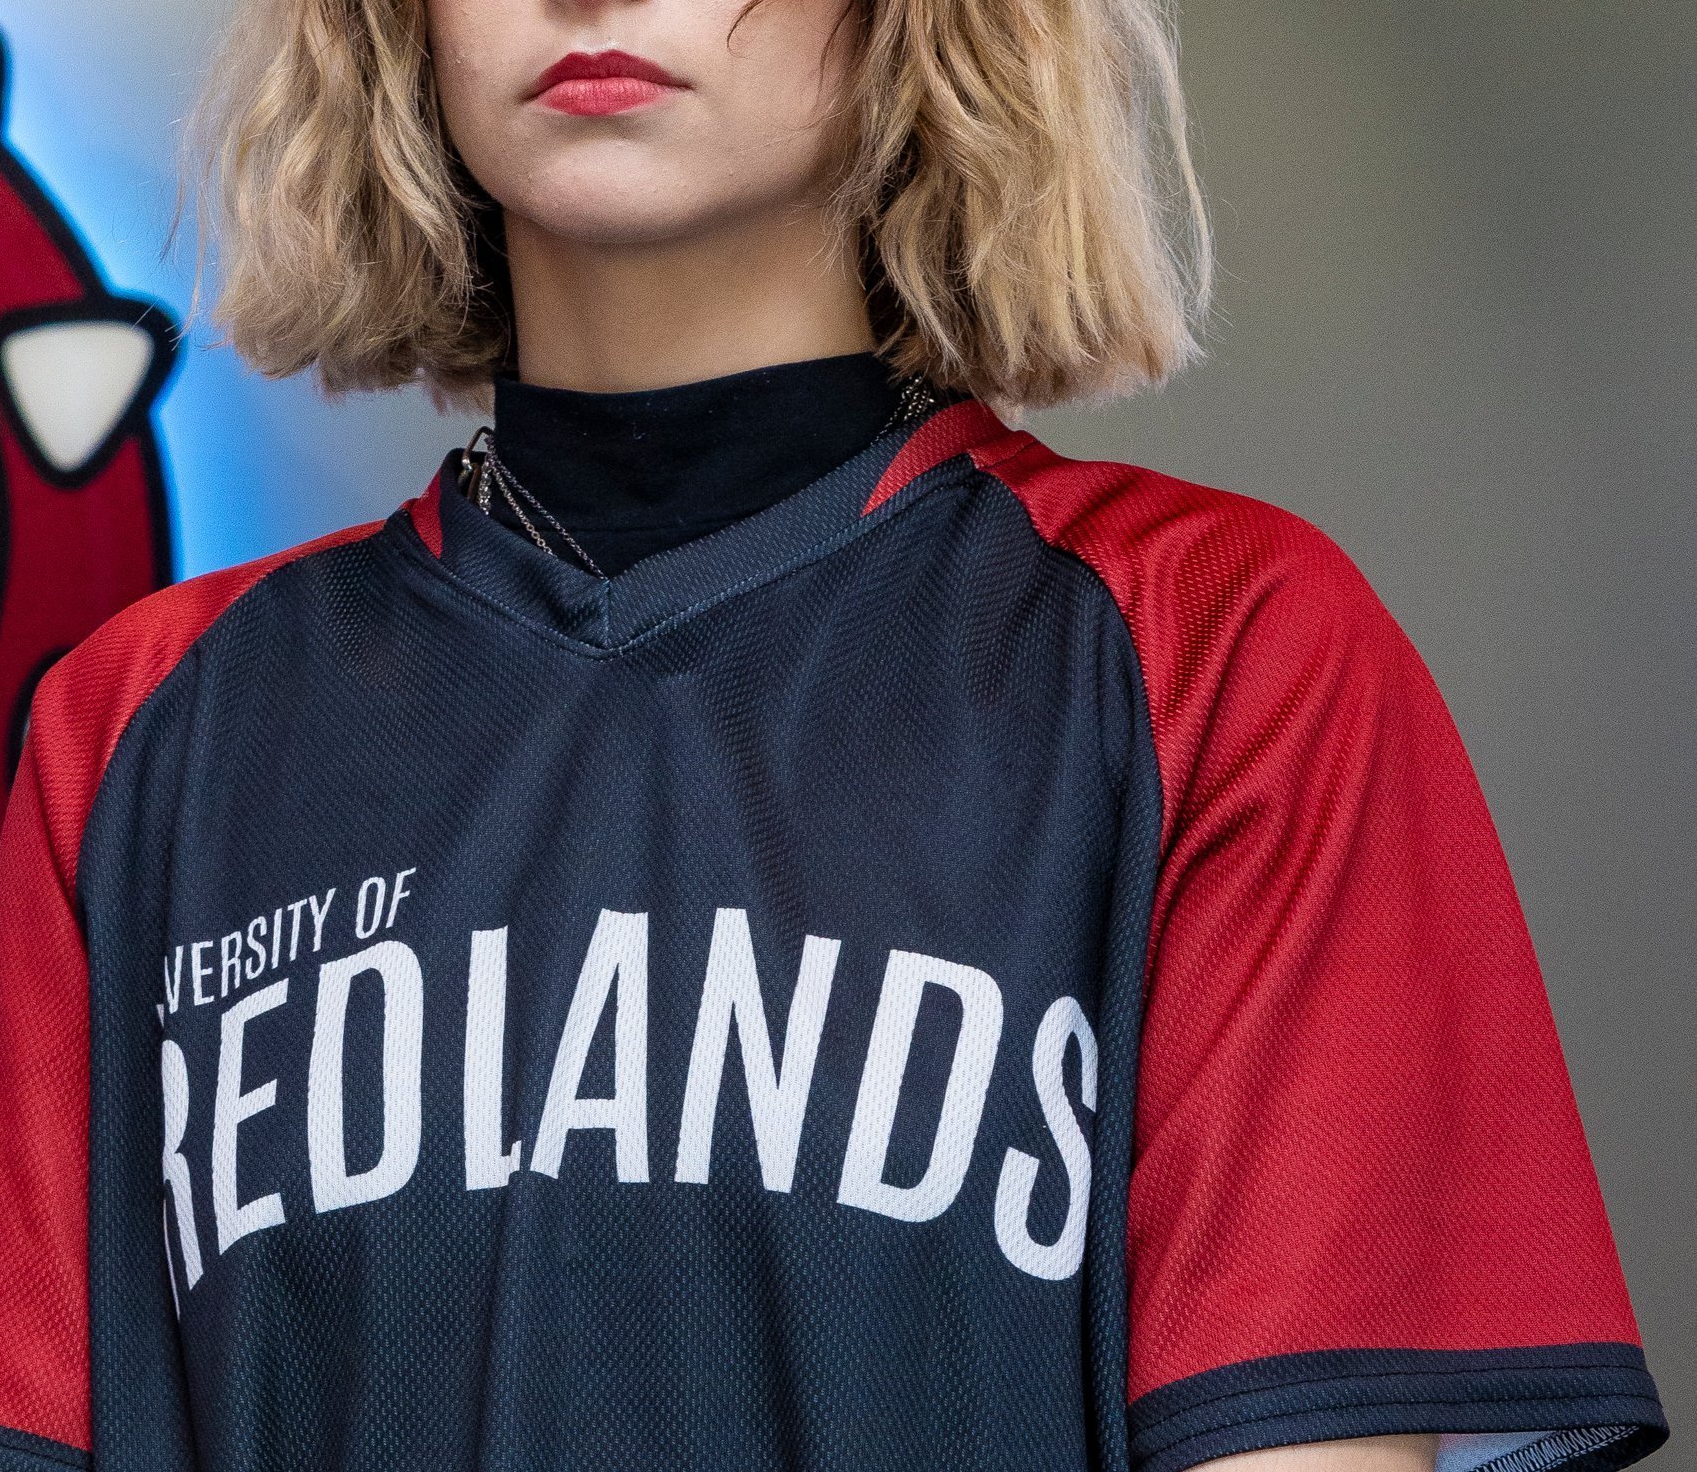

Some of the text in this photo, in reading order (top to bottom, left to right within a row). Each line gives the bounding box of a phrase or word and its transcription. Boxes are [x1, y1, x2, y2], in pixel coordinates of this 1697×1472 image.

[158, 866, 417, 1019] VERSITY OF
[161, 907, 1099, 1321] REDLANDS
